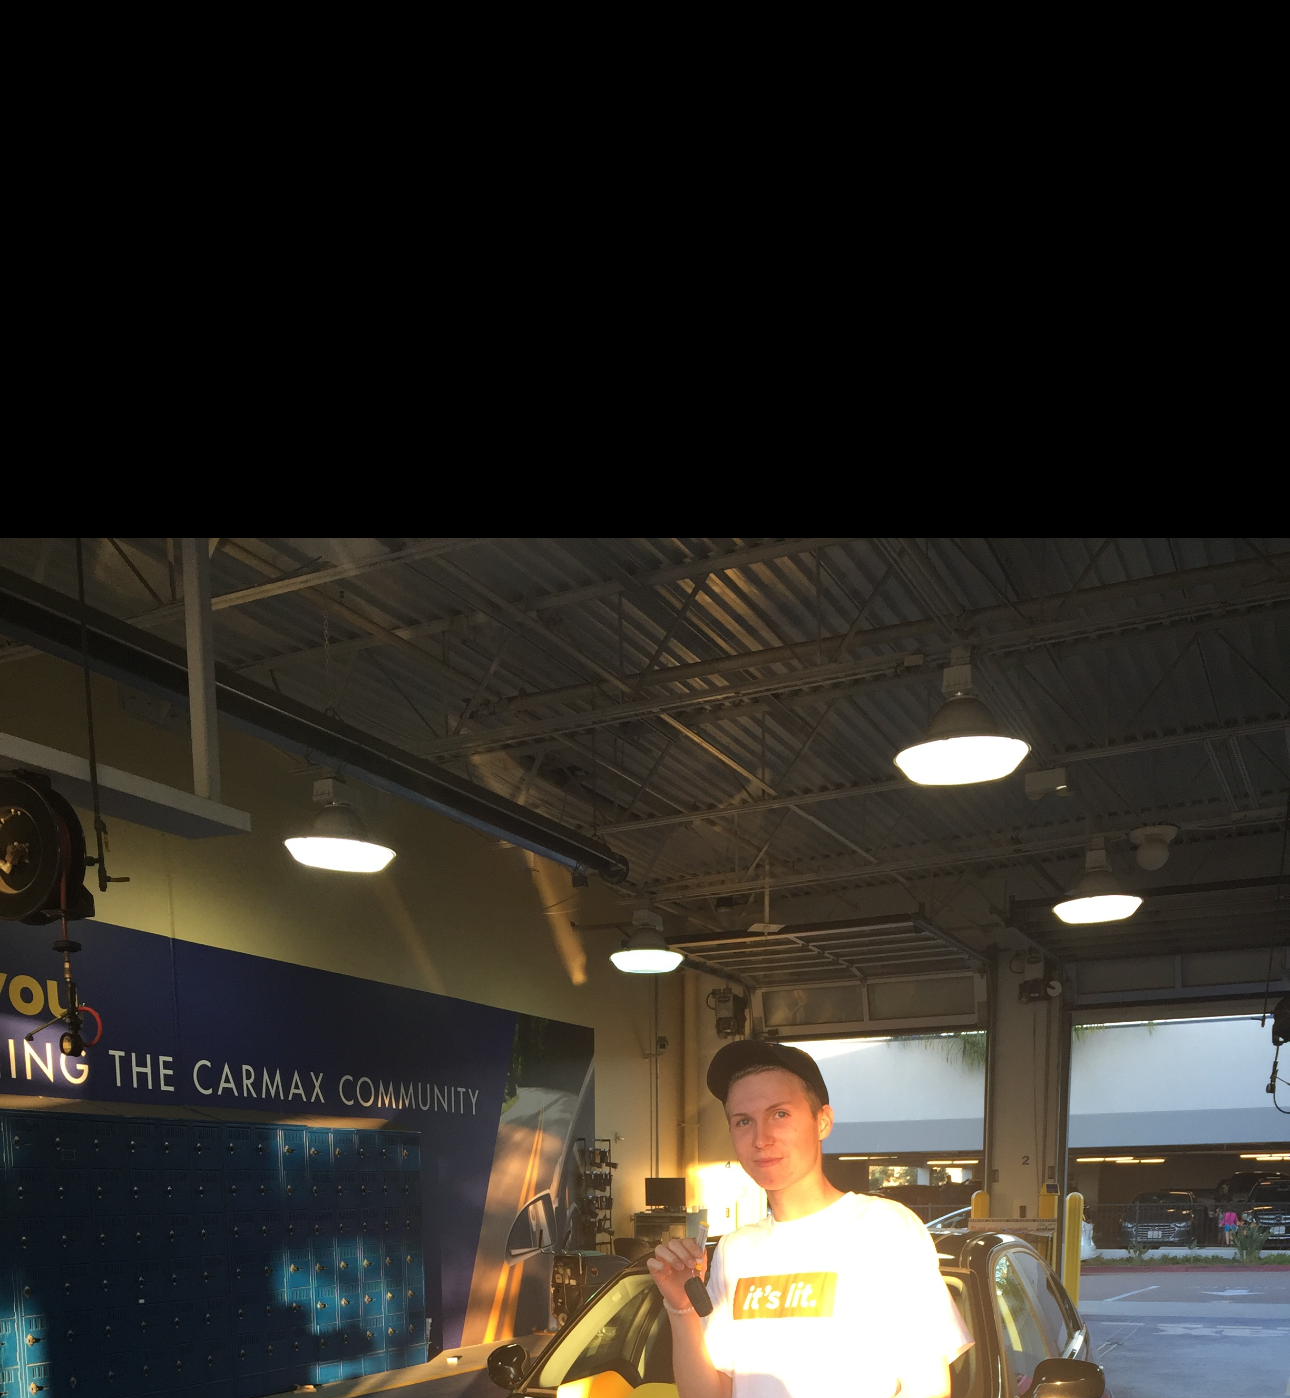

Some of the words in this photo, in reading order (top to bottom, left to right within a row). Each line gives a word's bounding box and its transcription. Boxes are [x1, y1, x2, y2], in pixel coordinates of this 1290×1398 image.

[0, 973, 78, 1018] ou
[0, 1038, 90, 1085] ING
[108, 1050, 175, 1092] THE
[192, 1059, 326, 1104] CARMAX
[338, 1074, 480, 1116] COMMUNITY
[1021, 1155, 1030, 1166] 2
[743, 1284, 782, 1311] it's
[784, 1281, 817, 1309] lit.
